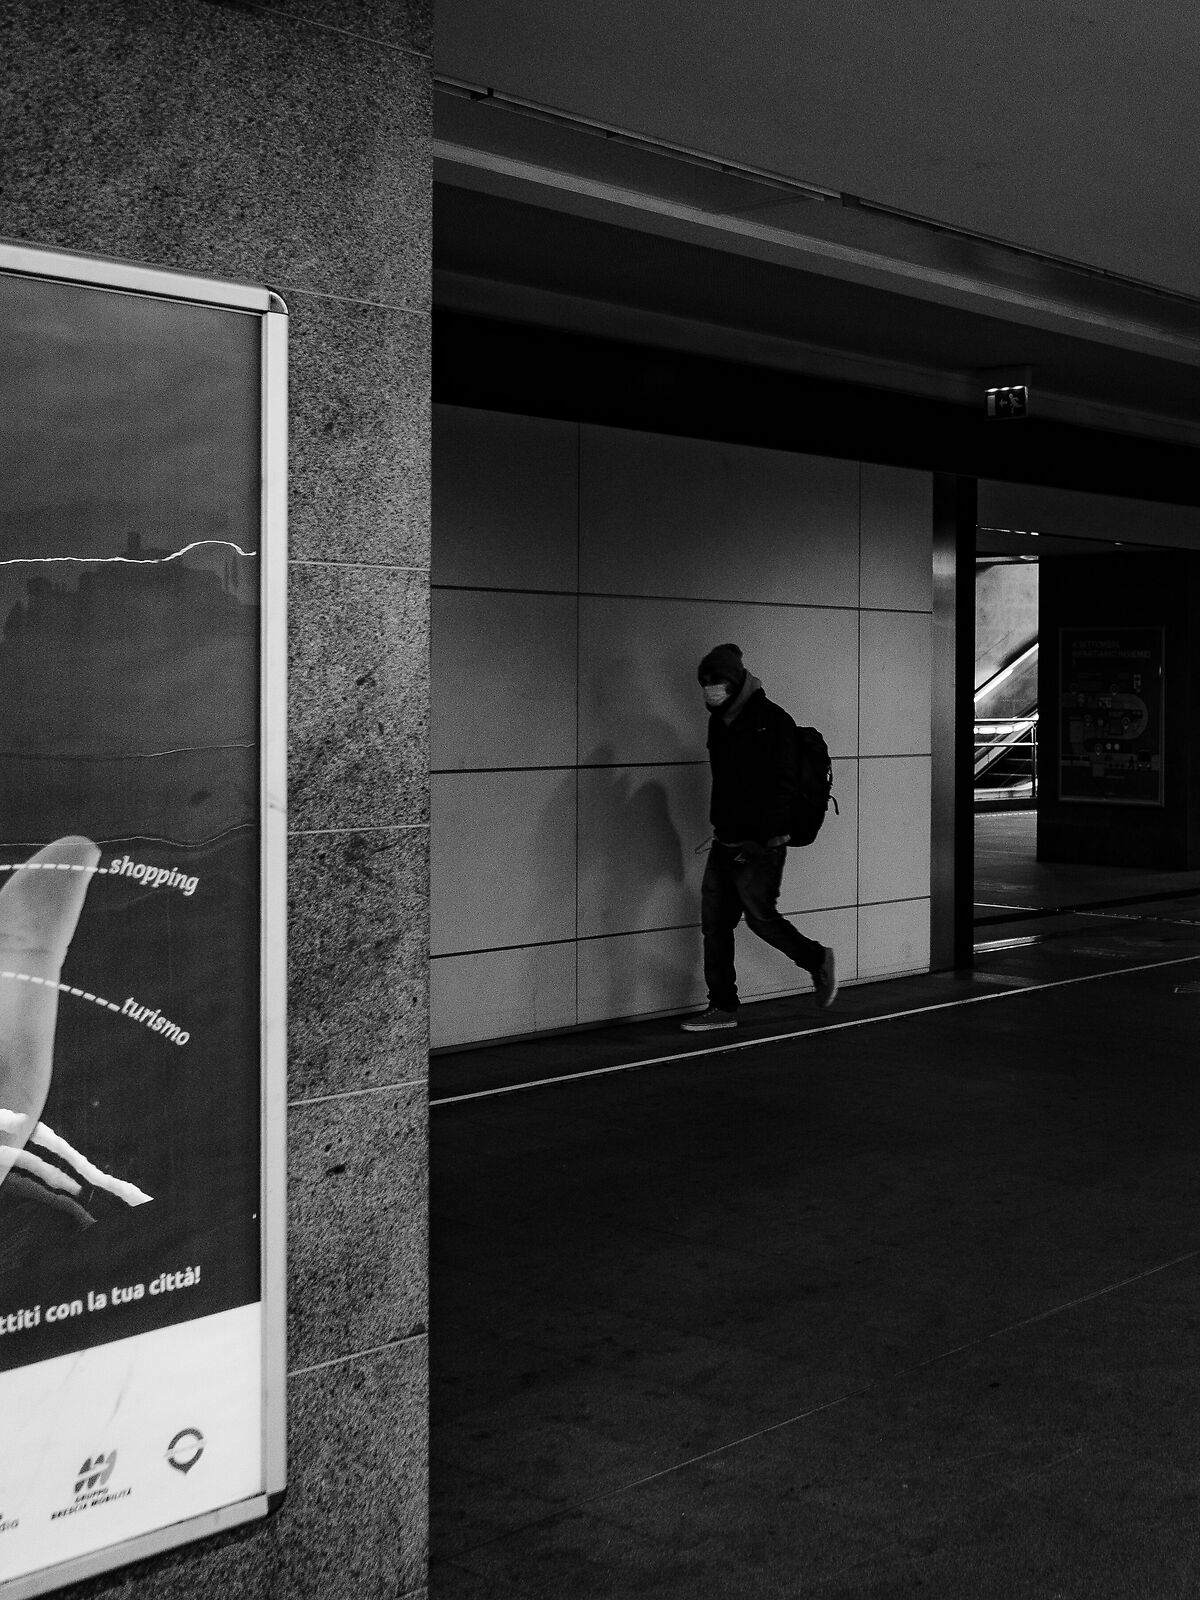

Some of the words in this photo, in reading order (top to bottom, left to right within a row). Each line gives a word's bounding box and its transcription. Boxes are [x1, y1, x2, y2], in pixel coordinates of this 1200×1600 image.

[110, 855, 199, 896] shopping
[121, 997, 190, 1046] turismo
[45, 1299, 83, 1323] con
[87, 1290, 107, 1312] la
[111, 1283, 145, 1306] tua
[149, 1265, 201, 1296] città!
